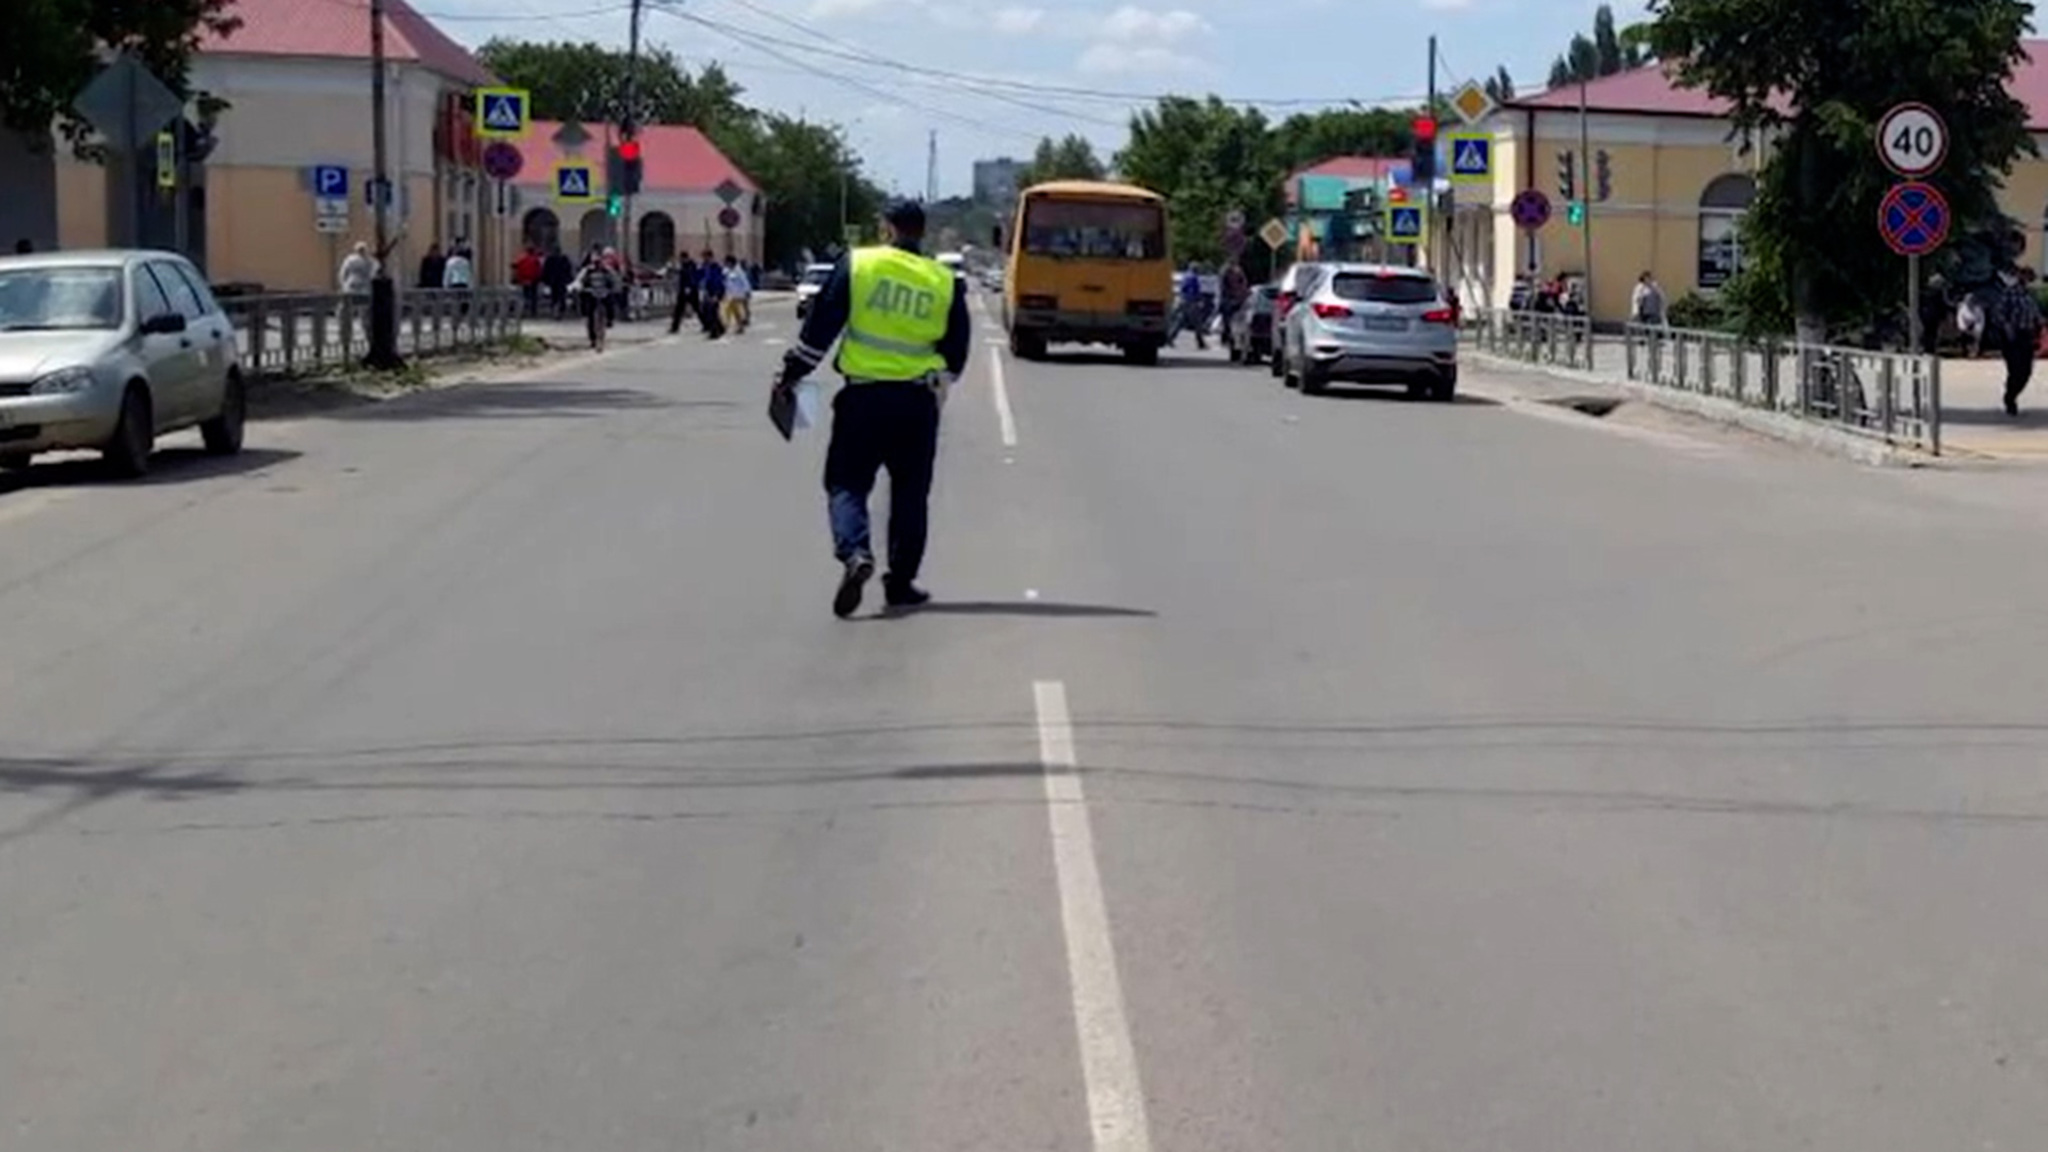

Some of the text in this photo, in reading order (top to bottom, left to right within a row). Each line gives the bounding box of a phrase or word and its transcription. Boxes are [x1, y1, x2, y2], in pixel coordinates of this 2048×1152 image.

[1892, 125, 1934, 157] 40
[321, 168, 341, 193] P
[866, 278, 935, 319] ДПС
